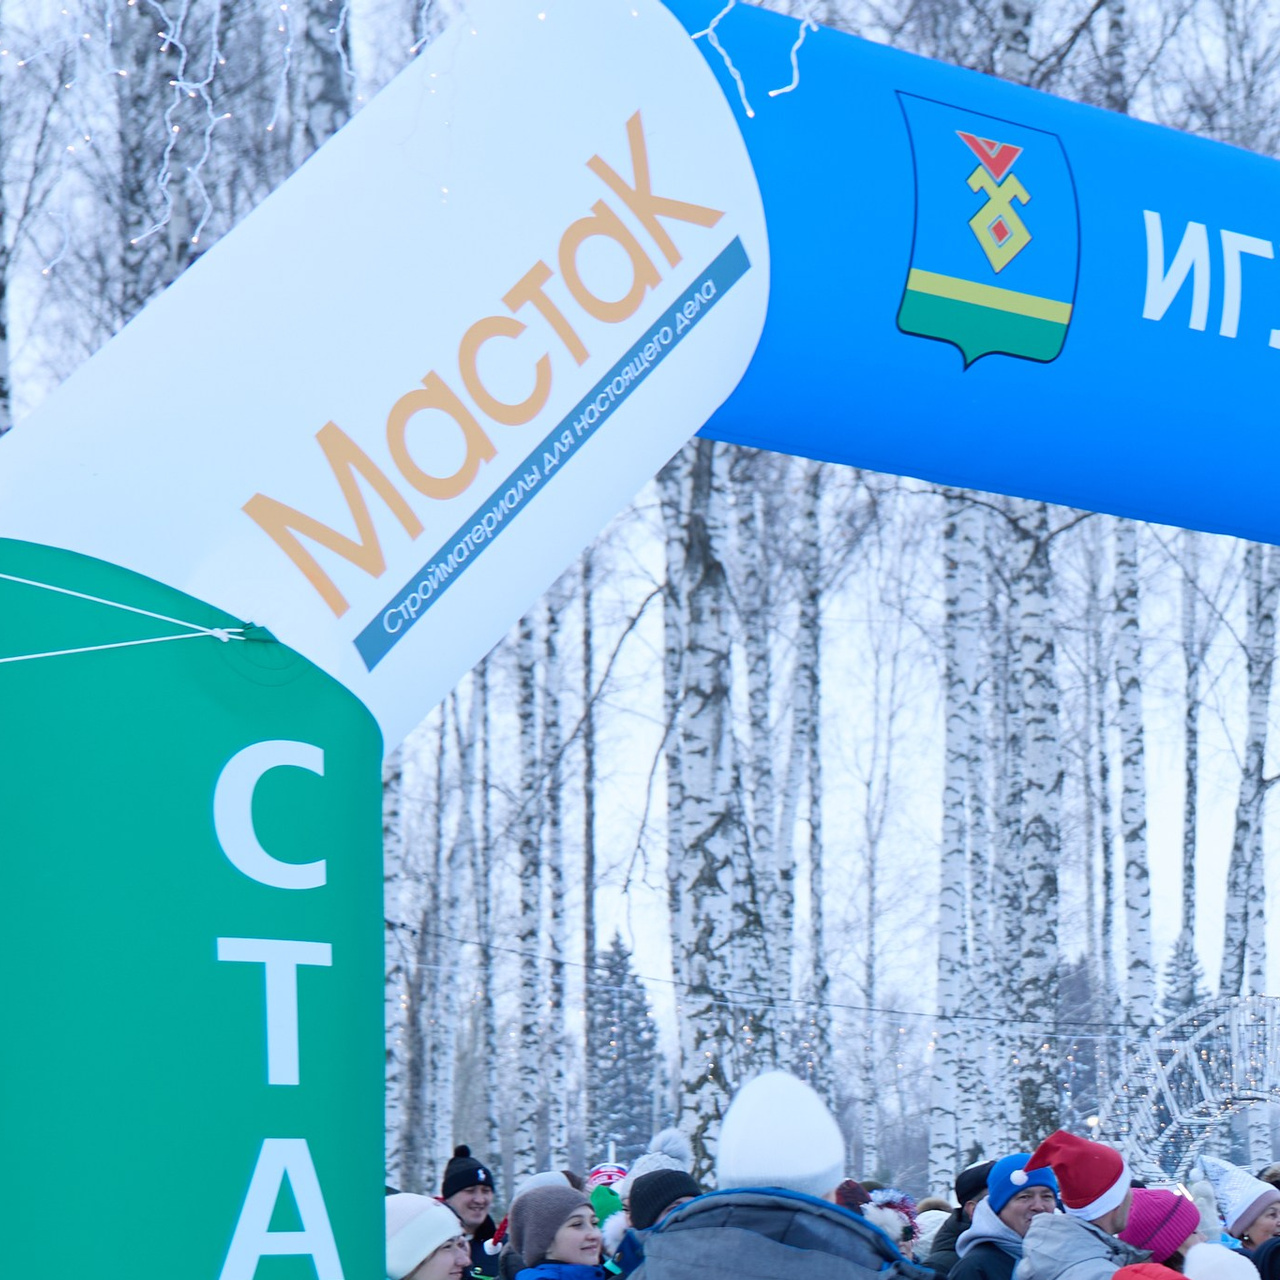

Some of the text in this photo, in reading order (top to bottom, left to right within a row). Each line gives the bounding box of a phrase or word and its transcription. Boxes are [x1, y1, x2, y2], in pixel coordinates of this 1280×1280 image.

[383, 278, 718, 634] Стройматериалы для настоящего дела
